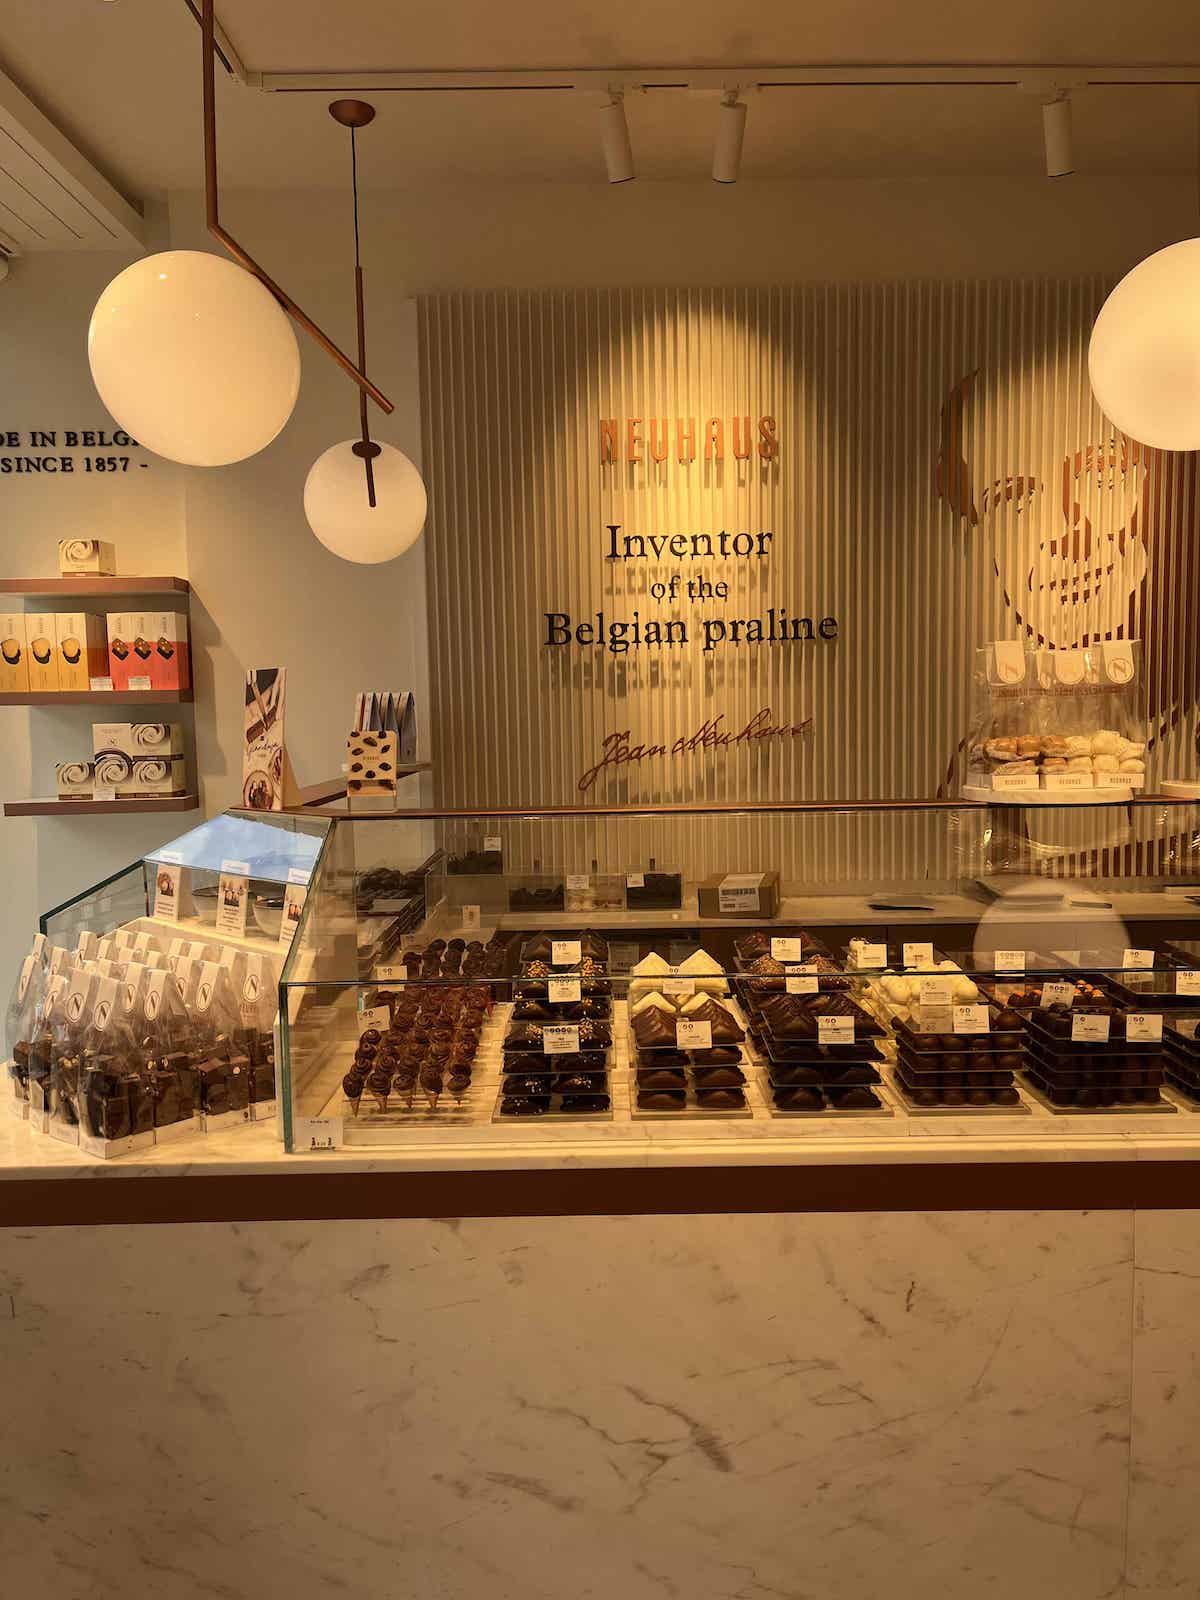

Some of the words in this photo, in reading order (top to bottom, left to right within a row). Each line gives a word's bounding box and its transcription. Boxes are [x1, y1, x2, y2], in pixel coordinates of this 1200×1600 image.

[30, 431, 56, 447] IN
[600, 416, 778, 462] NEUHAUS
[1, 457, 74, 473] SINCE
[84, 457, 130, 473] 1857
[606, 525, 773, 559] Inventor
[651, 575, 681, 600] of
[687, 575, 728, 599] the
[544, 611, 688, 653] Belgian
[702, 609, 838, 651] praline
